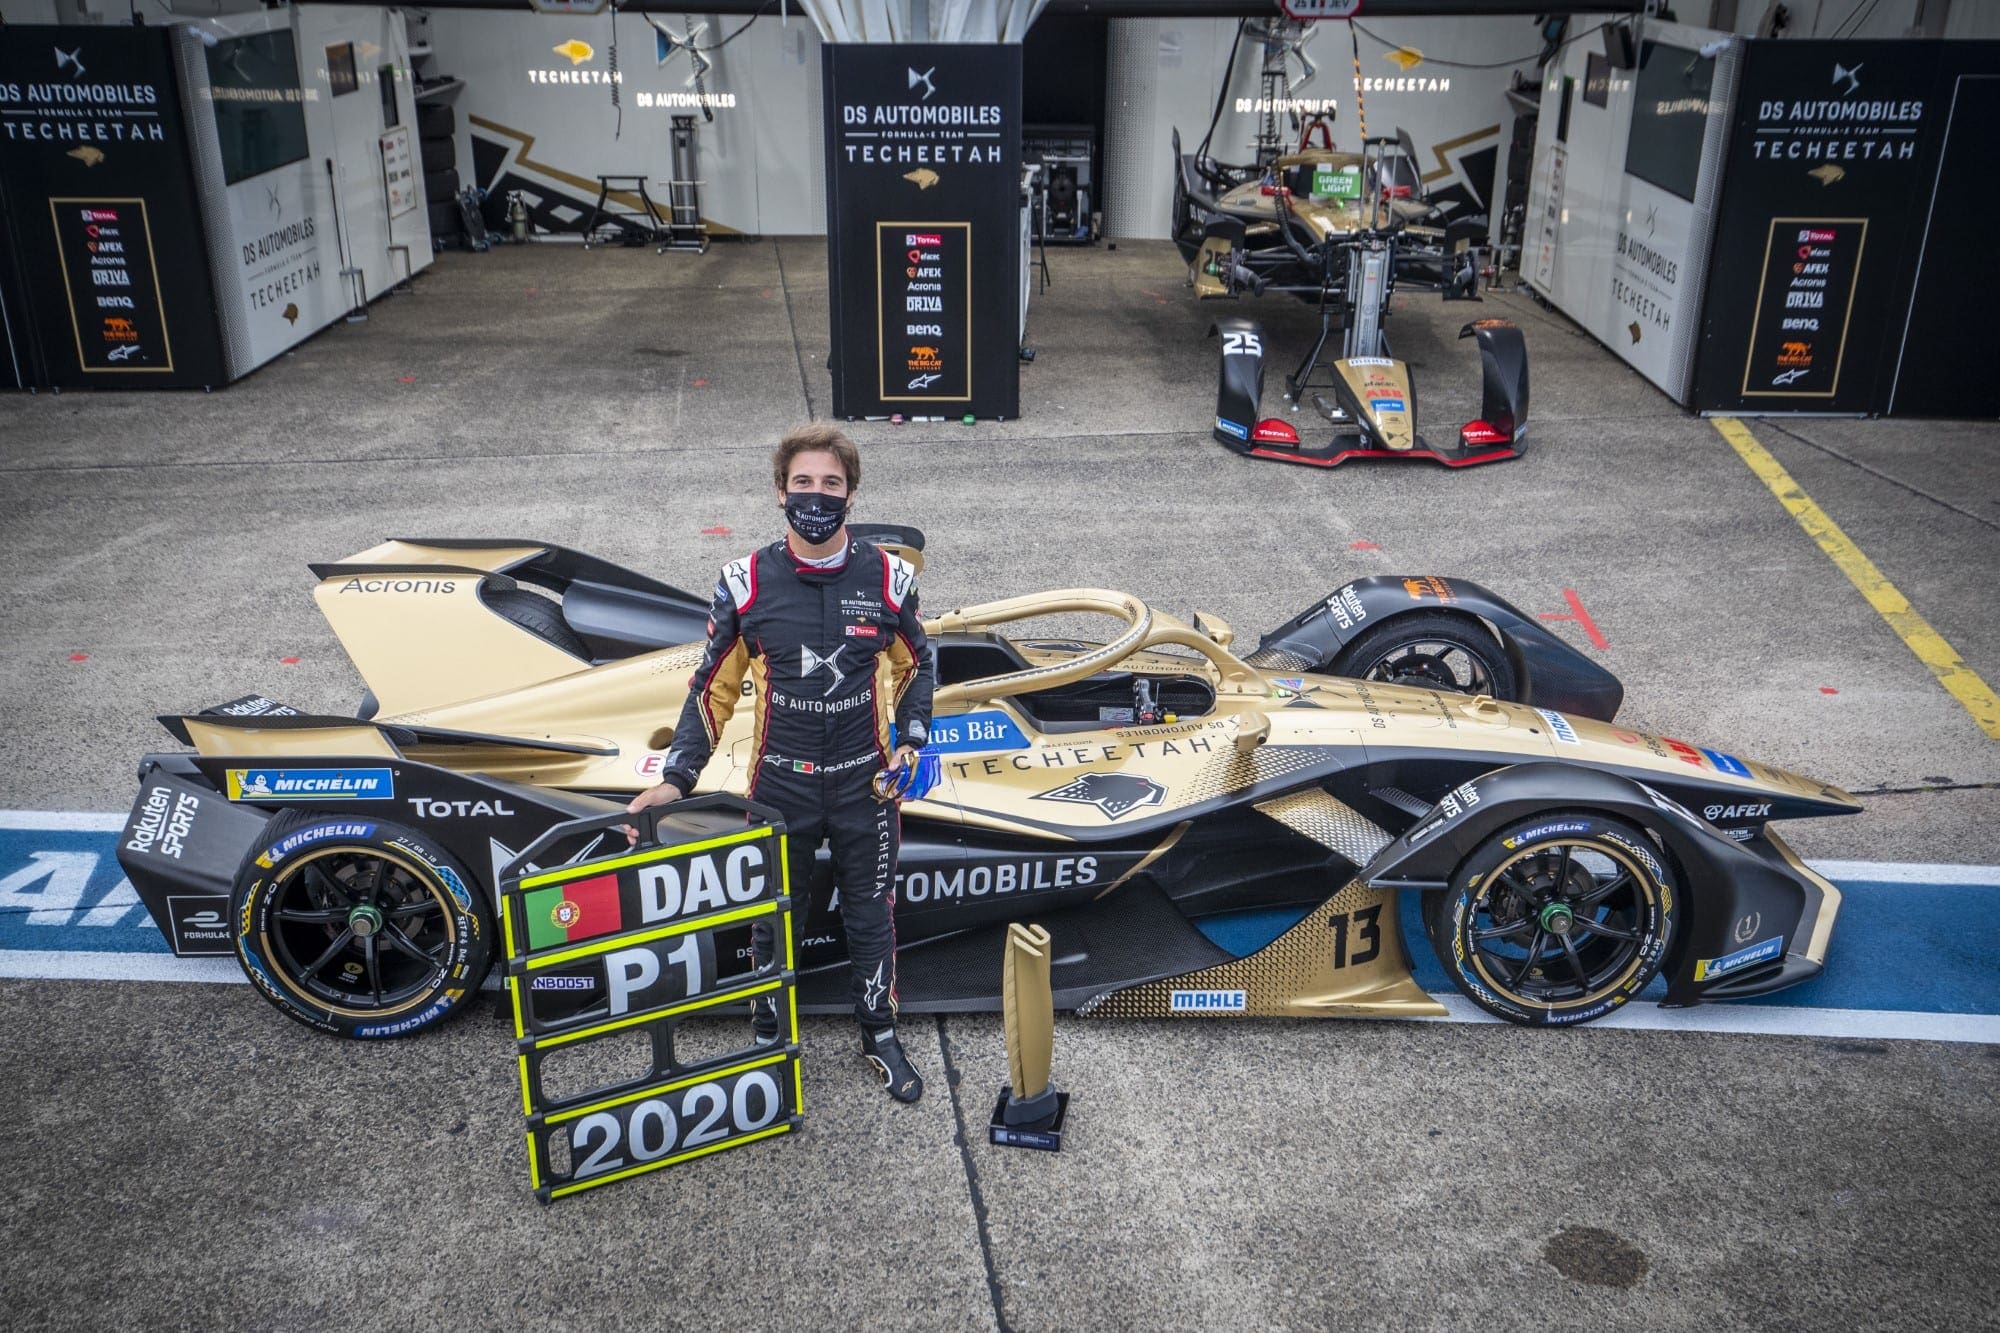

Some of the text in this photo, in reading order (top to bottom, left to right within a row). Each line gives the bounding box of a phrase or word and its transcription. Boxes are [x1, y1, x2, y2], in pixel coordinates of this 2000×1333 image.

[528, 70, 623, 84] TECHEETAH
[28, 84, 157, 104] AUTOMOBILES
[844, 105, 1000, 125] DS AUTOMOBILES
[1759, 101, 1923, 121] DS AUTOMOBILES
[4, 122, 163, 141] TECHEETAH
[940, 131, 963, 139] TEAM
[1854, 127, 1879, 135] TEAM
[845, 145, 1000, 163] TECHEETAH
[1753, 141, 1914, 159] TECHEETAH
[1319, 175, 1353, 185] GREEN
[1321, 184, 1352, 193] LIGHT
[242, 217, 314, 265] DS AUTOMOBILES
[1629, 239, 1677, 285] AUTOMOBILES
[1803, 264, 1829, 274] AFEX
[917, 268, 941, 278] AFEX
[251, 260, 320, 310] TECHEETAH
[907, 282, 942, 291] Acronis
[1790, 278, 1827, 287] Acronis
[907, 297, 942, 312] DRIVA
[1611, 278, 1670, 332] TECHEETAH
[907, 325, 942, 336] BenQ
[1223, 333, 1262, 357] 25
[339, 578, 456, 593] Acronis
[772, 692, 785, 706] DS
[967, 722, 1008, 741] Bär
[1115, 722, 1225, 739] DS AUTOMOBILES
[645, 757, 662, 774] E
[844, 761, 856, 769] DA
[953, 735, 1211, 780] TECHEETAH
[275, 778, 378, 790] MICHELIN
[408, 798, 515, 818] TOTAL
[1721, 804, 1772, 818] AFEX
[126, 786, 172, 853] Rakuten
[161, 792, 200, 859] SPORTS
[282, 824, 367, 851] MICHELIN
[1525, 822, 1584, 839] MICHELIN
[637, 844, 766, 924] DAC
[1329, 904, 1383, 970] 13
[1723, 945, 1775, 970] MICHELIN
[605, 932, 700, 1016] P1
[1174, 993, 1243, 1007] MAHLE
[361, 1006, 441, 1037] MICHELIN
[572, 1070, 780, 1181] 2020
